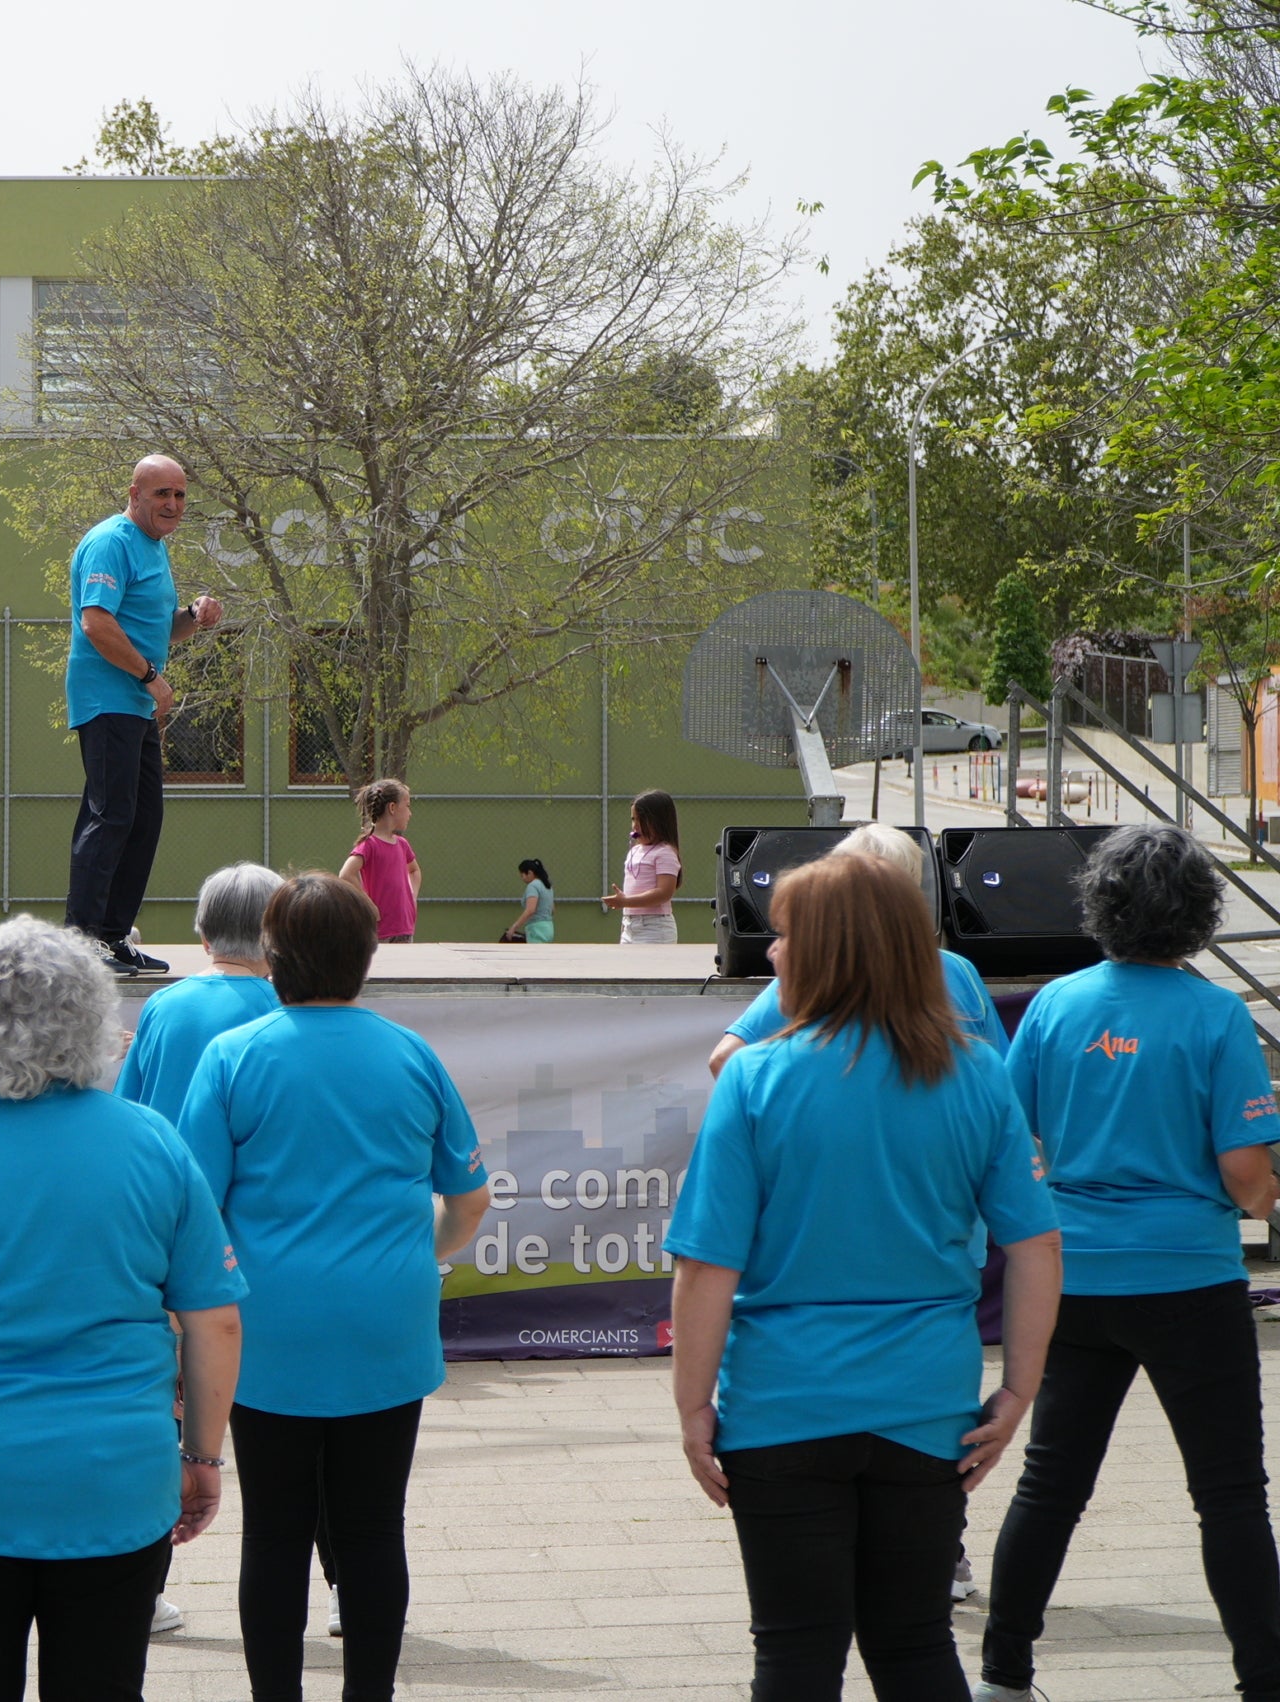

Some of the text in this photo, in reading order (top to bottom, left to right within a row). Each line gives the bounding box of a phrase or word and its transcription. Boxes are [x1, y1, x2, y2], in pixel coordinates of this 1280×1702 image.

[1084, 1029, 1138, 1060] Ana
[540, 1168, 688, 1210] com
[475, 1221, 551, 1275] de
[518, 1329, 639, 1345] COMERCIANTS
